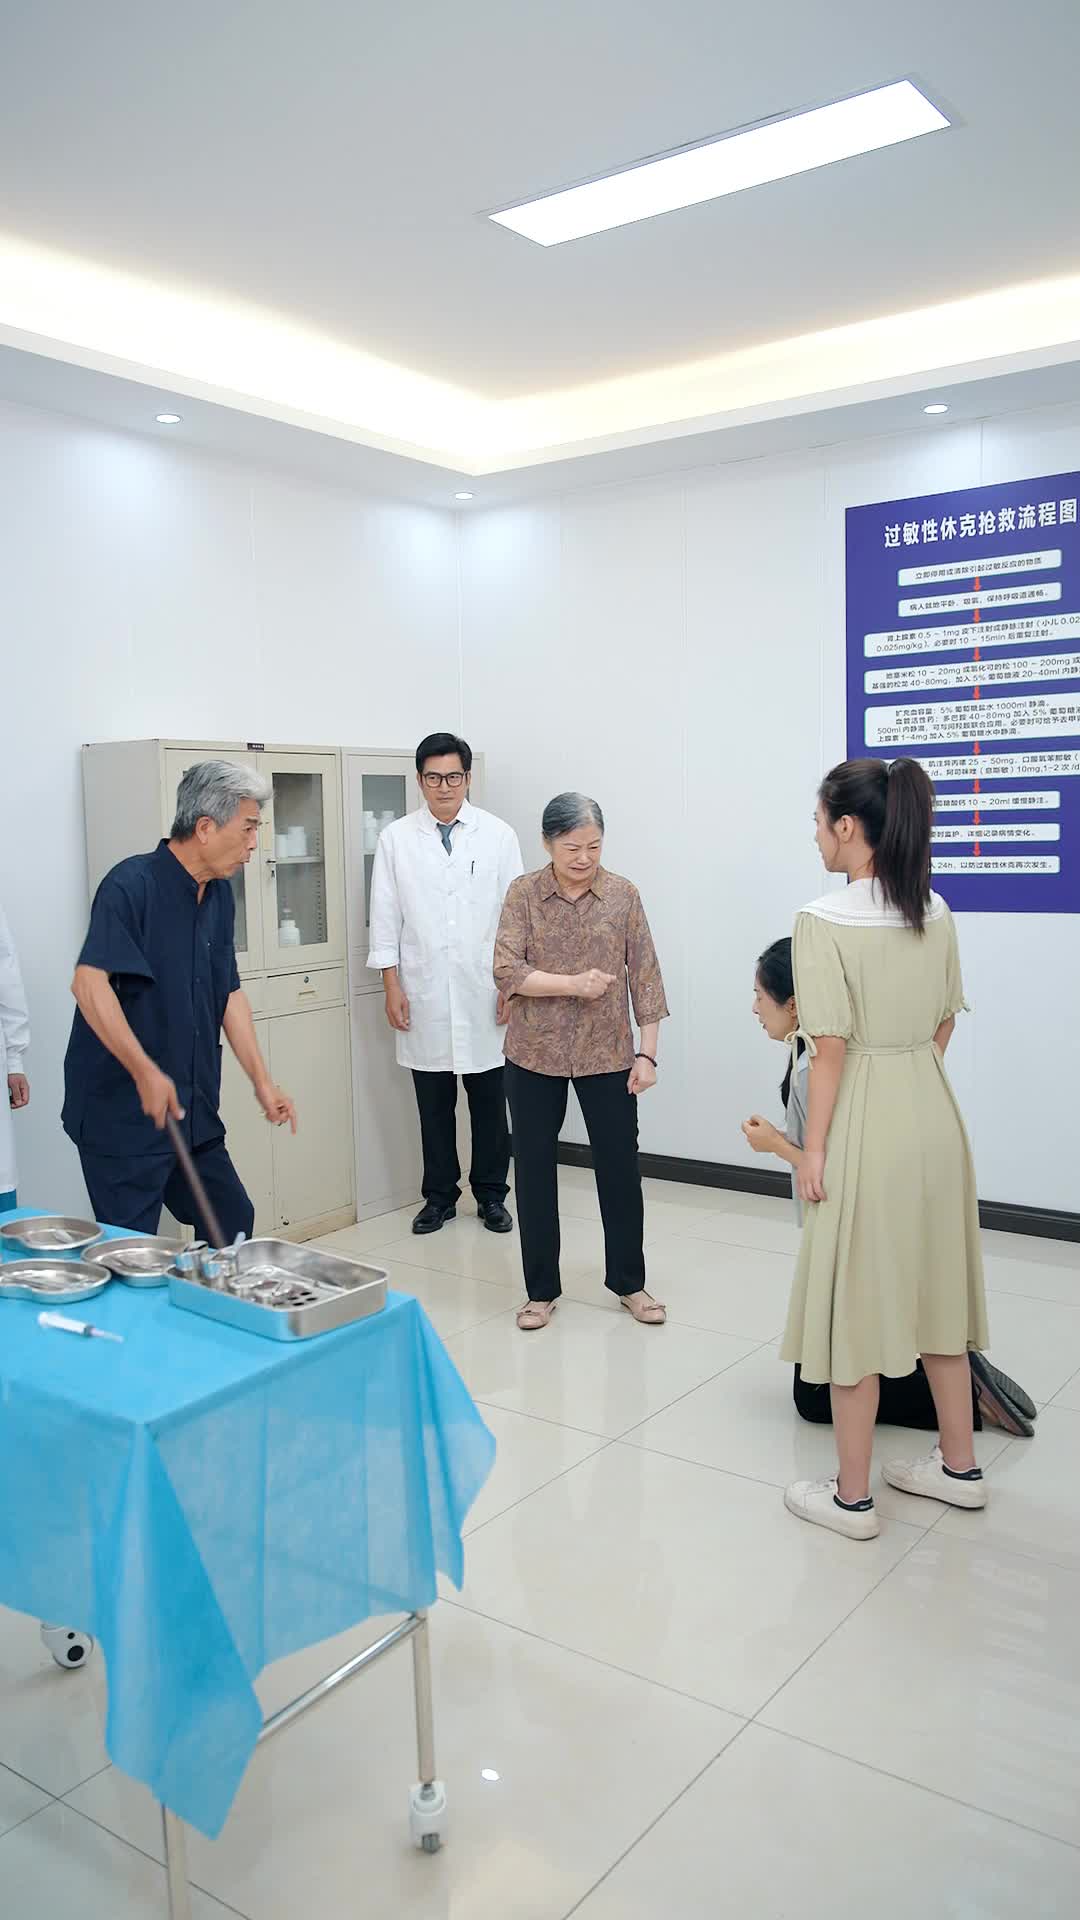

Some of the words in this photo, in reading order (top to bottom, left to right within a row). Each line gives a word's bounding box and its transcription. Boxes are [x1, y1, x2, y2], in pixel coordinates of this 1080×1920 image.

[884, 498, 1077, 548] 过敏性休克抢救流程图
